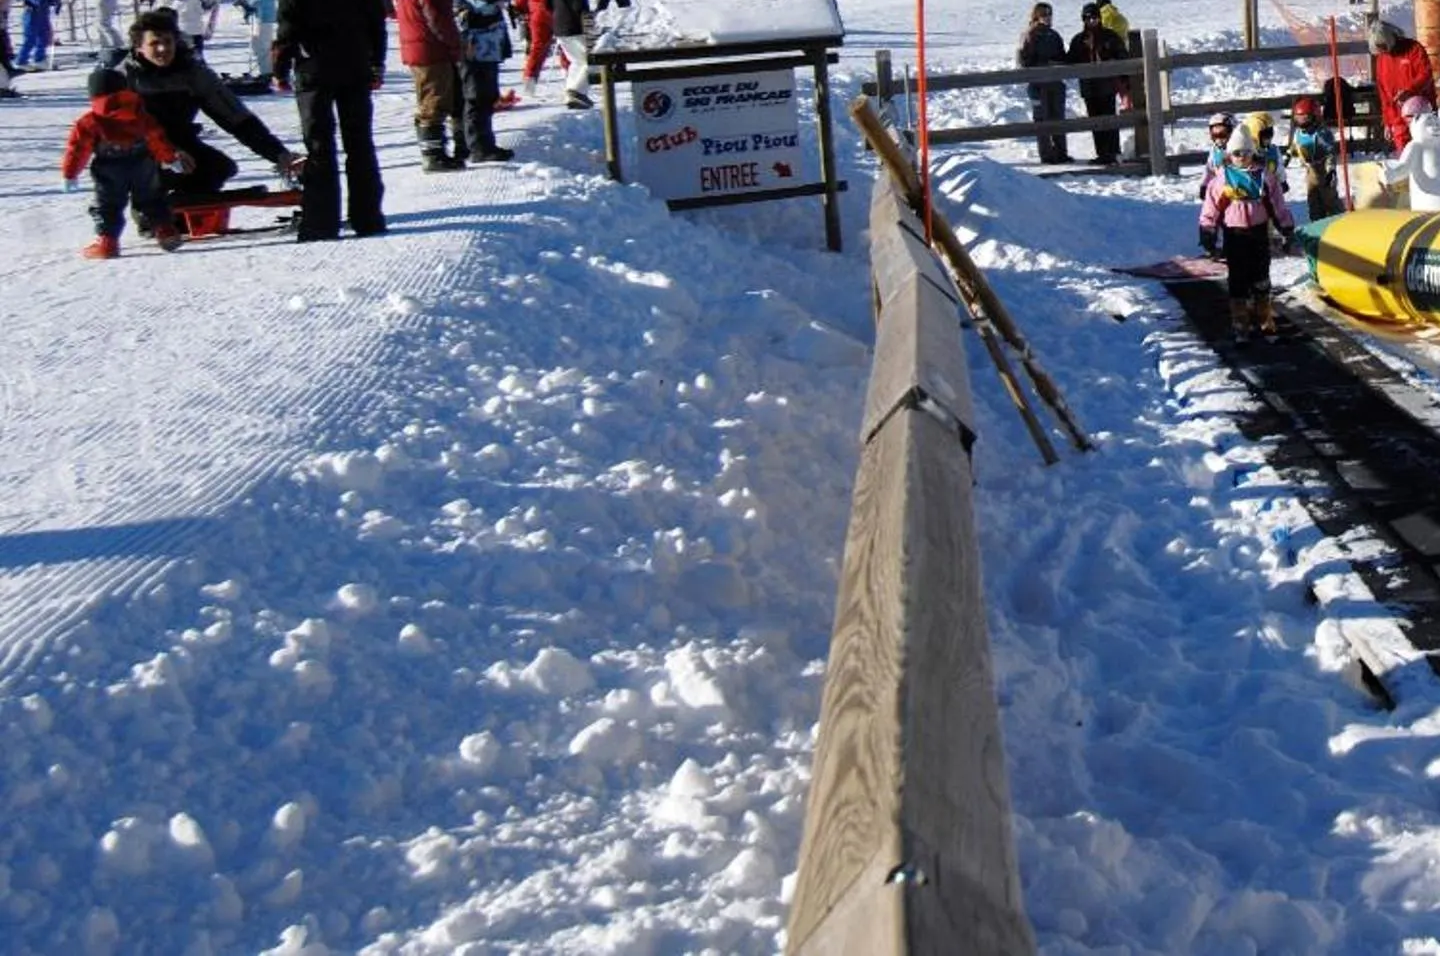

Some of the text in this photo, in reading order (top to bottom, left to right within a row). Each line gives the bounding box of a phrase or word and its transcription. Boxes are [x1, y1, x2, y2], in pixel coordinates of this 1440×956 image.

[683, 81, 760, 96] ECOLE DU
[685, 96, 711, 107] SKI
[646, 125, 798, 156] Club Piou Piou
